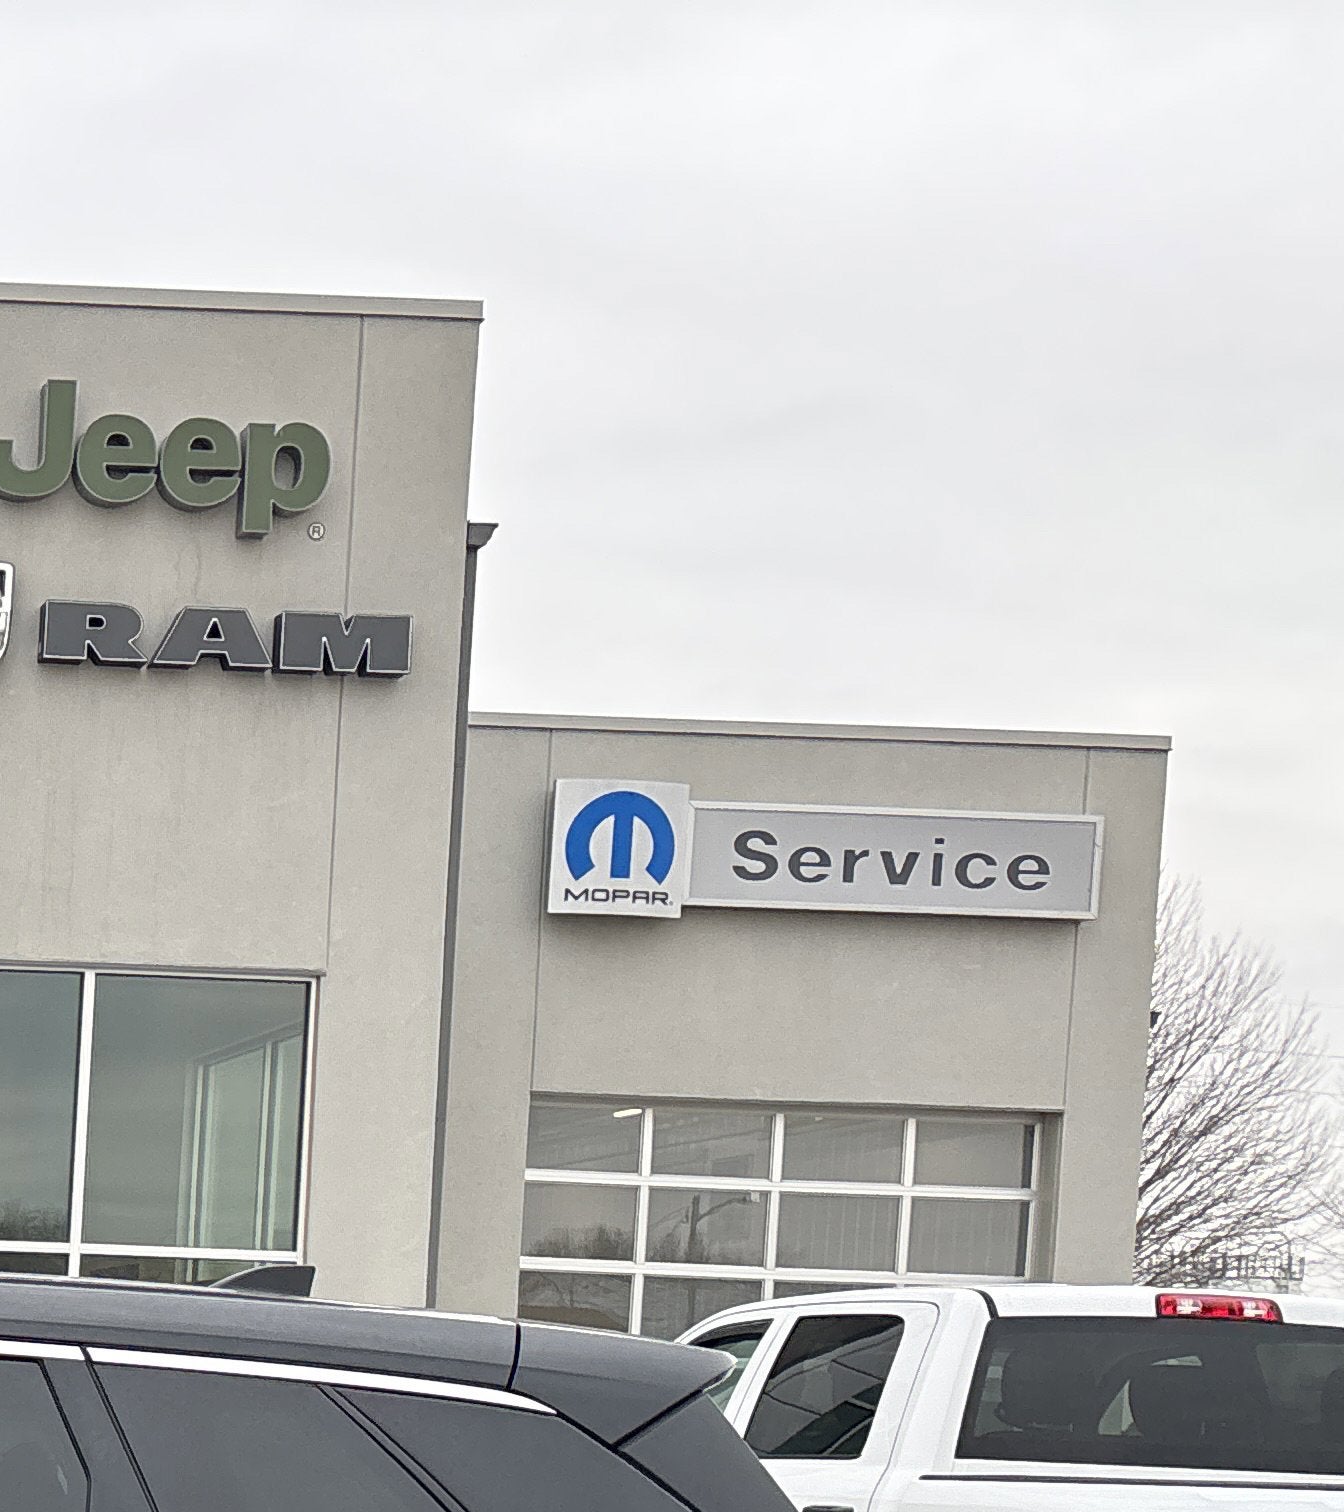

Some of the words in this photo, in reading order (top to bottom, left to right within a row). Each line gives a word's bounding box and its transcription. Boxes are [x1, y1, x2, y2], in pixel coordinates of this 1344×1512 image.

[38, 599, 414, 678] RAM
[732, 830, 1051, 892] Service
[563, 887, 670, 906] MOPAR
